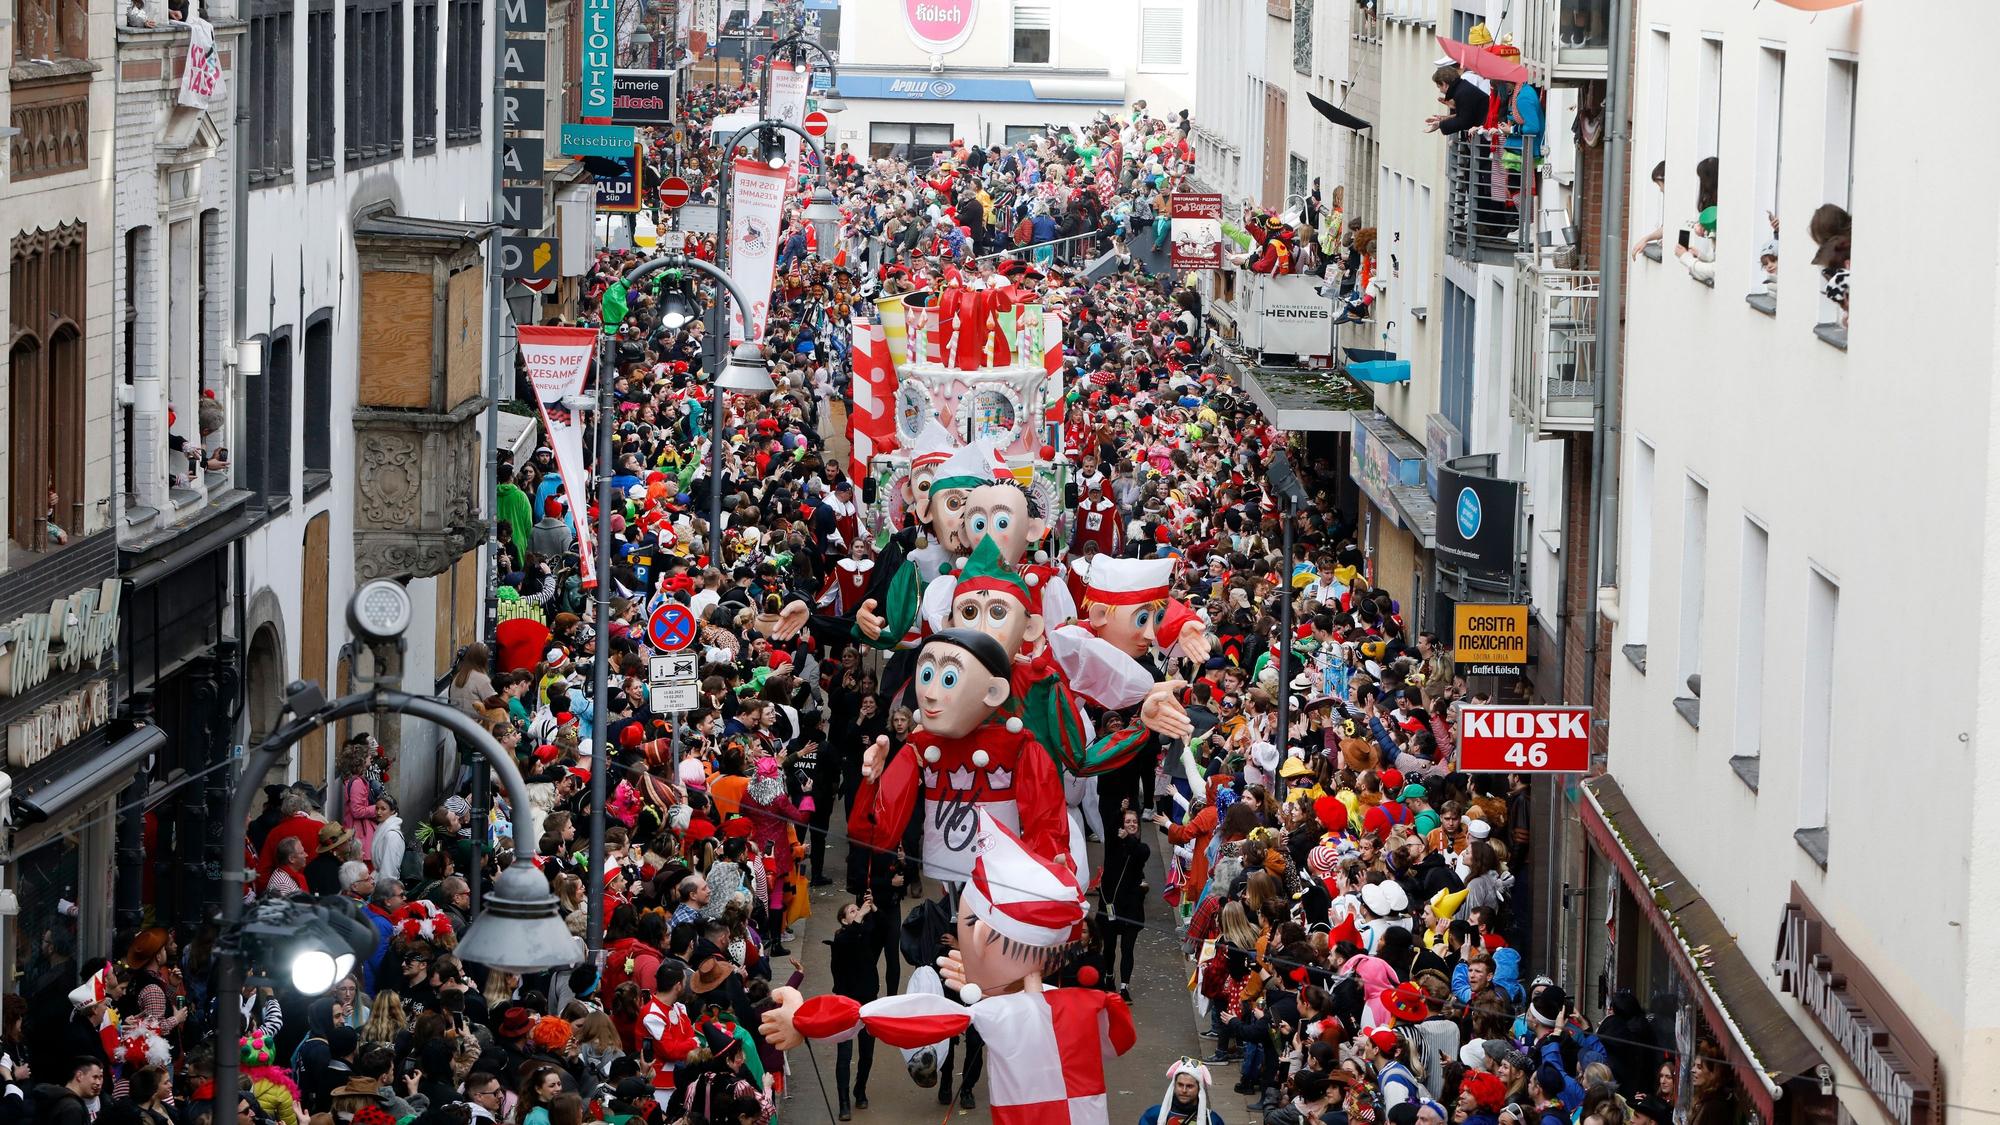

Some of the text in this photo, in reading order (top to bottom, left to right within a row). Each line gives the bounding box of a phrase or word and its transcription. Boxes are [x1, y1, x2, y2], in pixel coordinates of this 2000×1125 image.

[915, 3, 961, 24] Kölsch
[563, 134, 632, 148] Reisebüro
[597, 182, 632, 195] ALDI
[605, 194, 620, 202] SÜD
[1265, 309, 1328, 319] HENNES
[527, 354, 556, 366] LOSS
[637, 567, 646, 580] P
[1468, 616, 1515, 632] CASITA
[1459, 635, 1524, 651] MEXICANA
[1472, 665, 1520, 675] Gaffel Kölsch
[1463, 712, 1588, 739] KIOSK
[1504, 743, 1548, 767] 46
[794, 761, 816, 769] SWAT
